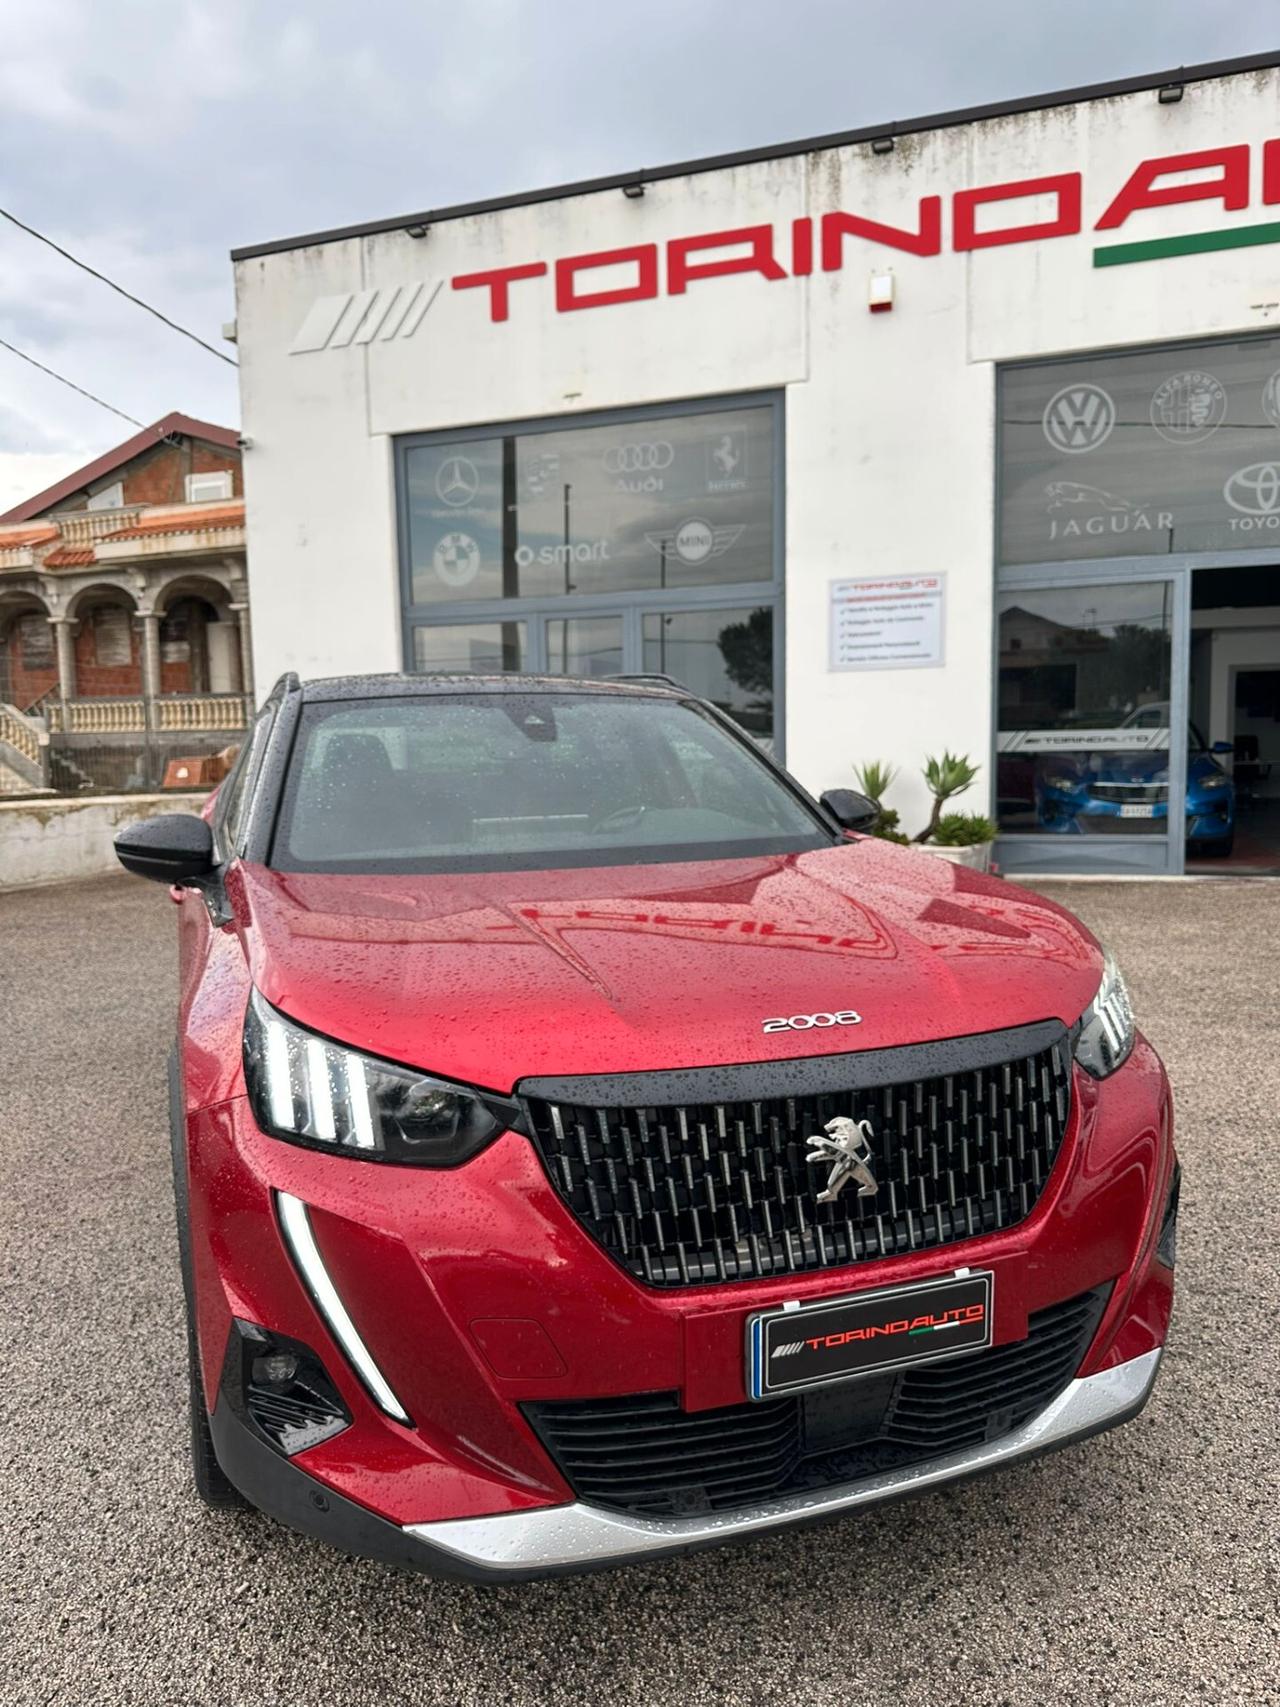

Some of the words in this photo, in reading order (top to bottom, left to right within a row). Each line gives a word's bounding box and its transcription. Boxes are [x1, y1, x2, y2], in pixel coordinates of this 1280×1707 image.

[452, 138, 1280, 323] TORINOA
[1050, 511, 1174, 539] JAGUAR
[537, 539, 611, 565] smart
[680, 535, 711, 548] MINI
[761, 1009, 862, 1033] 2008
[805, 1303, 985, 1351] TORINOAUTO
